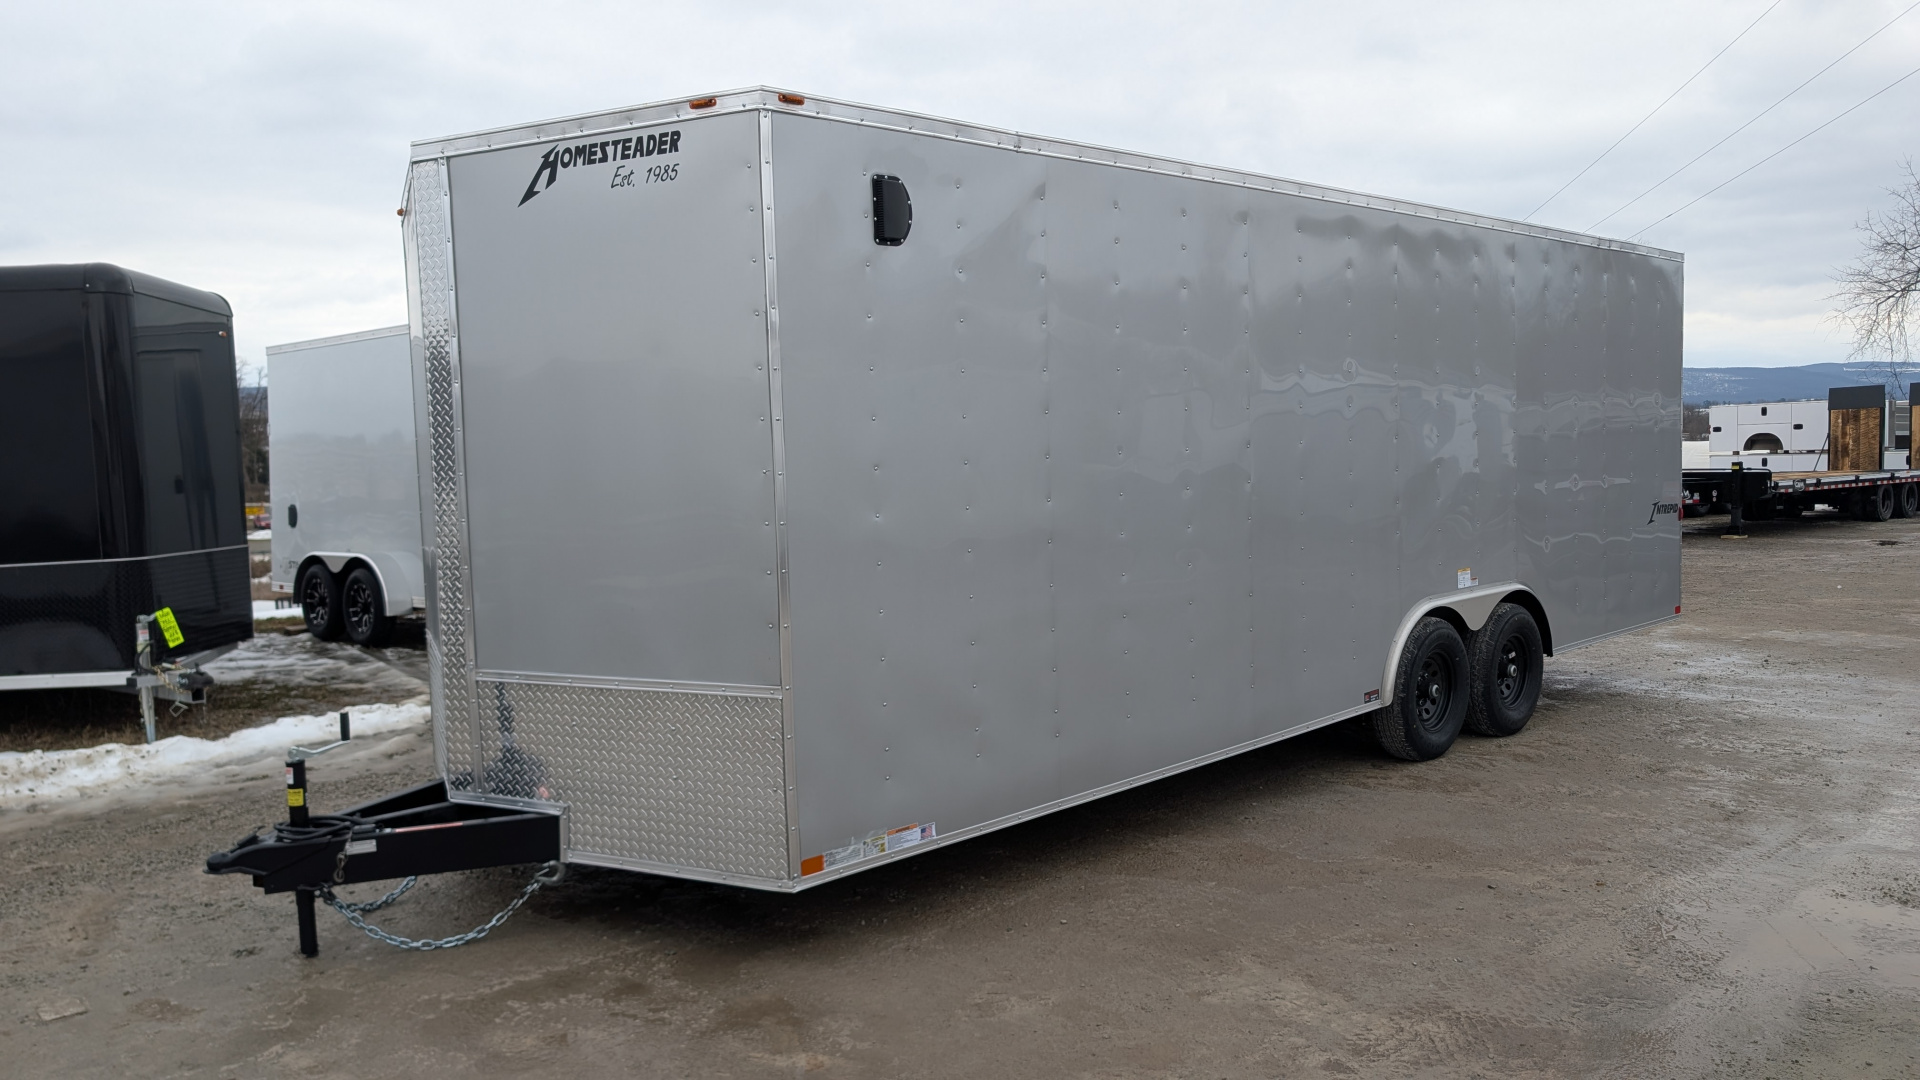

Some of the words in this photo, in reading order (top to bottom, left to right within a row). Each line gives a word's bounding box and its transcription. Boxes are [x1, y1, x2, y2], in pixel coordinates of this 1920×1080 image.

[517, 130, 682, 208] HOMESTEADER
[610, 164, 636, 189] Est.
[645, 163, 680, 184] 1985
[1646, 500, 1679, 526] INTREPID
